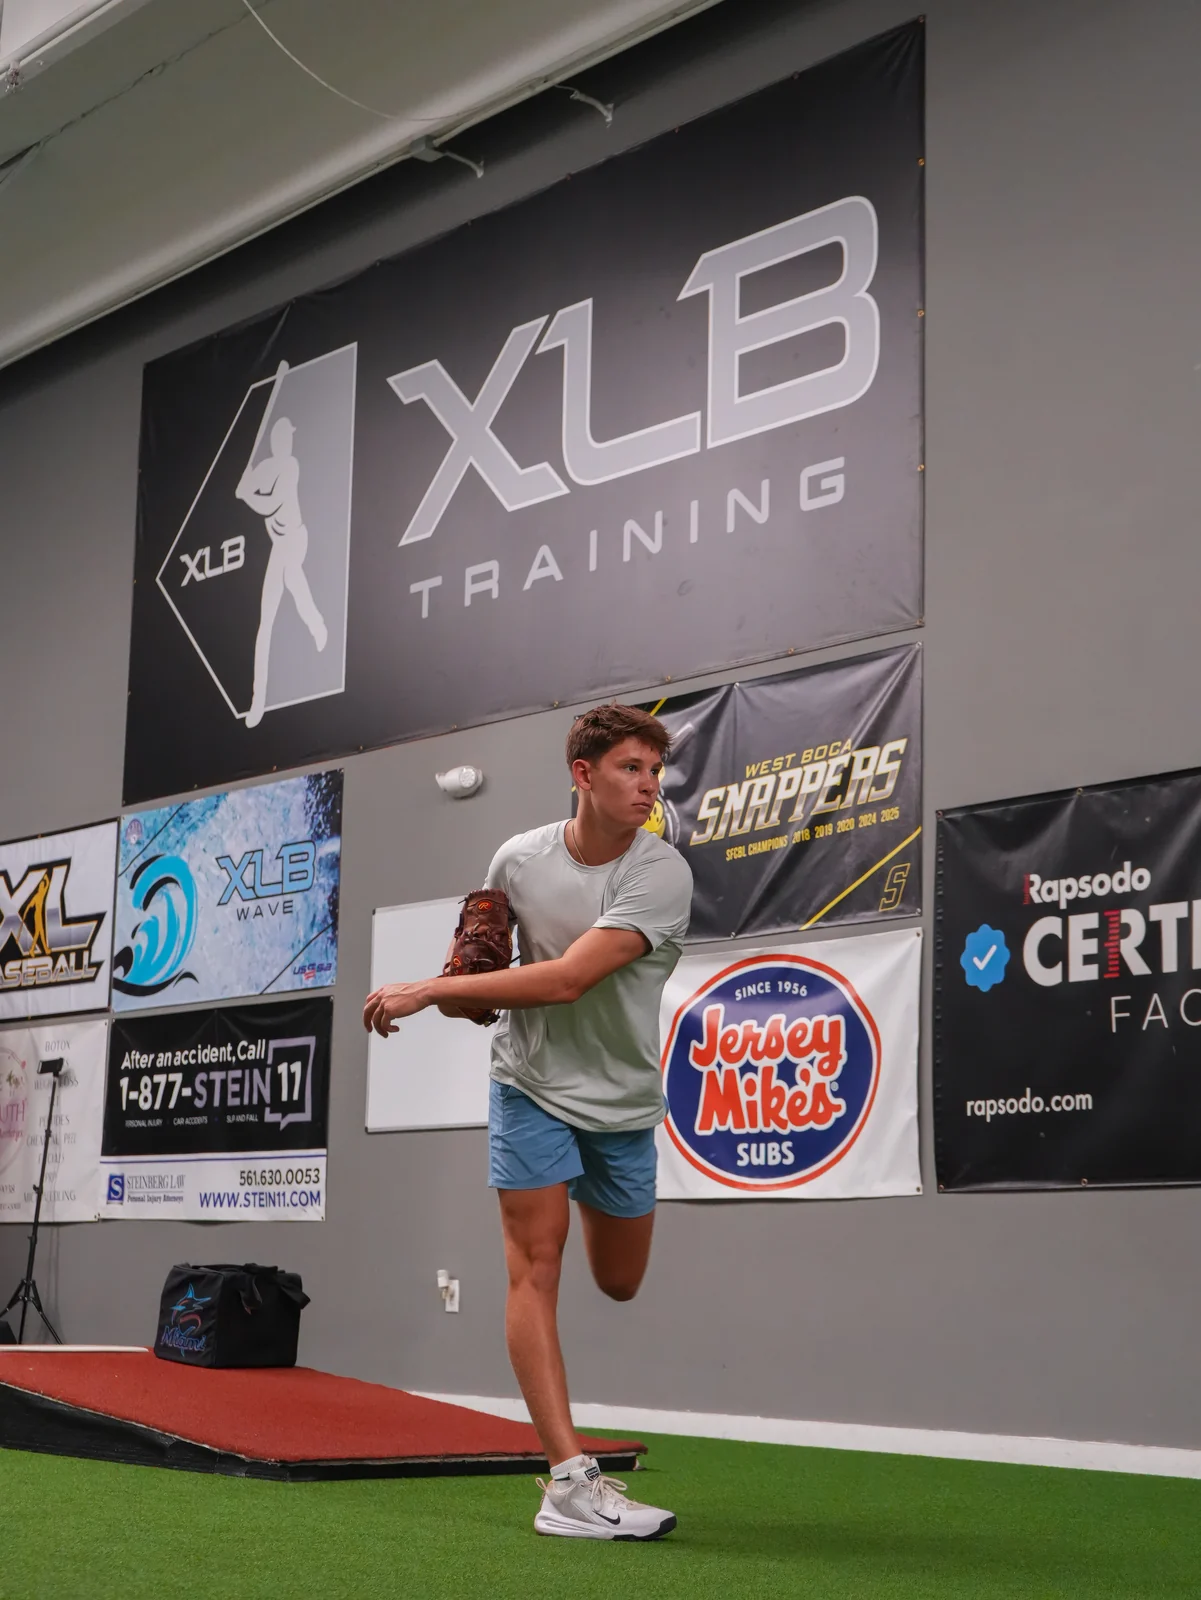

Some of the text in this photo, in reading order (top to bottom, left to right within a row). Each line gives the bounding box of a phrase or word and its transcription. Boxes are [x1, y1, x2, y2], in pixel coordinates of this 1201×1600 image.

[386, 195, 880, 547] XLB
[410, 457, 846, 619] TRAINING
[180, 535, 246, 588] XLB
[745, 738, 852, 778] WEST BOCA
[690, 738, 907, 846] SNAPPERS
[726, 806, 900, 861] SFCBL CHAMPIONS 2018 2019 2020 2024 2025
[216, 840, 316, 906] XLB
[878, 863, 911, 911] S
[1023, 861, 1152, 909] Rapsodo
[236, 900, 294, 921] WAVE
[735, 981, 808, 1001] SINCE 1956
[45, 1041, 71, 1052] BOTOX
[121, 1039, 266, 1070] After an accident, Call
[690, 1005, 845, 1078] Jersey
[277, 1061, 302, 1102] 11
[696, 1064, 846, 1133] Mike's
[966, 1087, 1093, 1122] rapsodo.com
[736, 1141, 795, 1166] SUBS
[126, 1174, 186, 1189] STEINBERG LAW
[239, 1168, 320, 1186] 561.630.0053
[199, 1191, 321, 1208] WWW.STEIN11.COM
[161, 1326, 207, 1351] Miami
